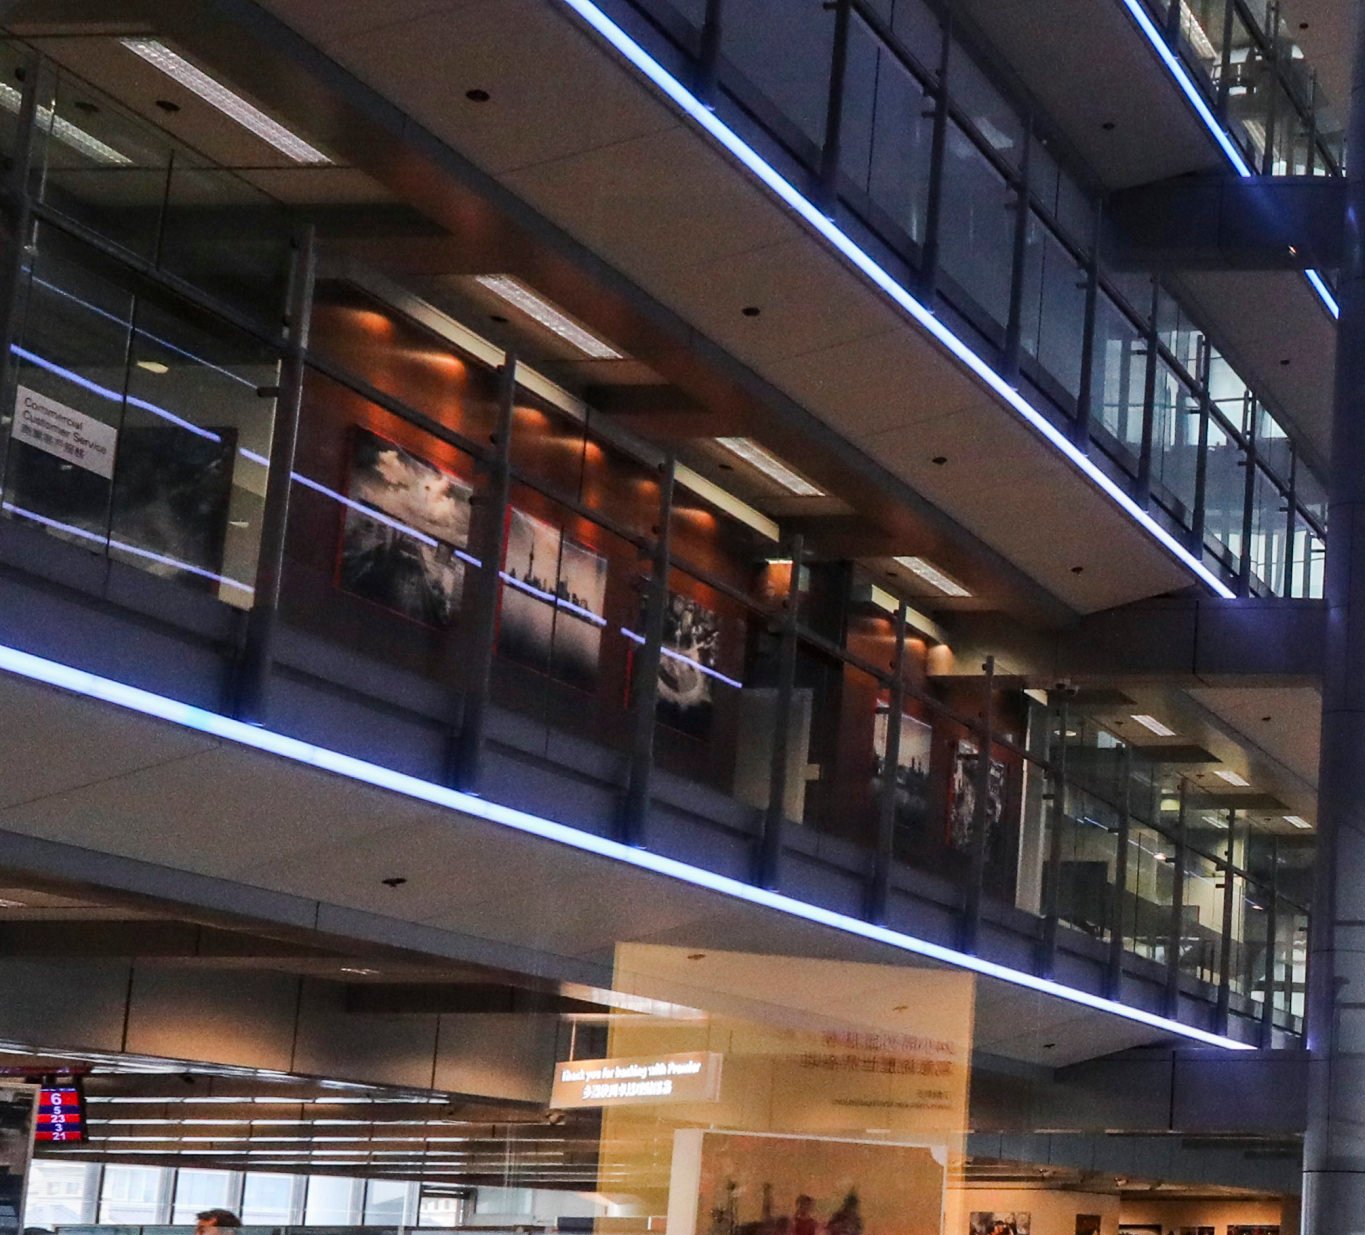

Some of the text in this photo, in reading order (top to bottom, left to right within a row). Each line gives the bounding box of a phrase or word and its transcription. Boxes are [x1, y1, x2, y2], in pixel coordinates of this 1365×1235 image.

[24, 397, 83, 431] Commercial
[22, 410, 107, 455] Customer Service
[51, 1093, 62, 1105] 6
[53, 1106, 61, 1114] 5
[50, 1115, 66, 1123] 23
[54, 1123, 63, 1132] 3
[52, 1132, 66, 1140] 21
